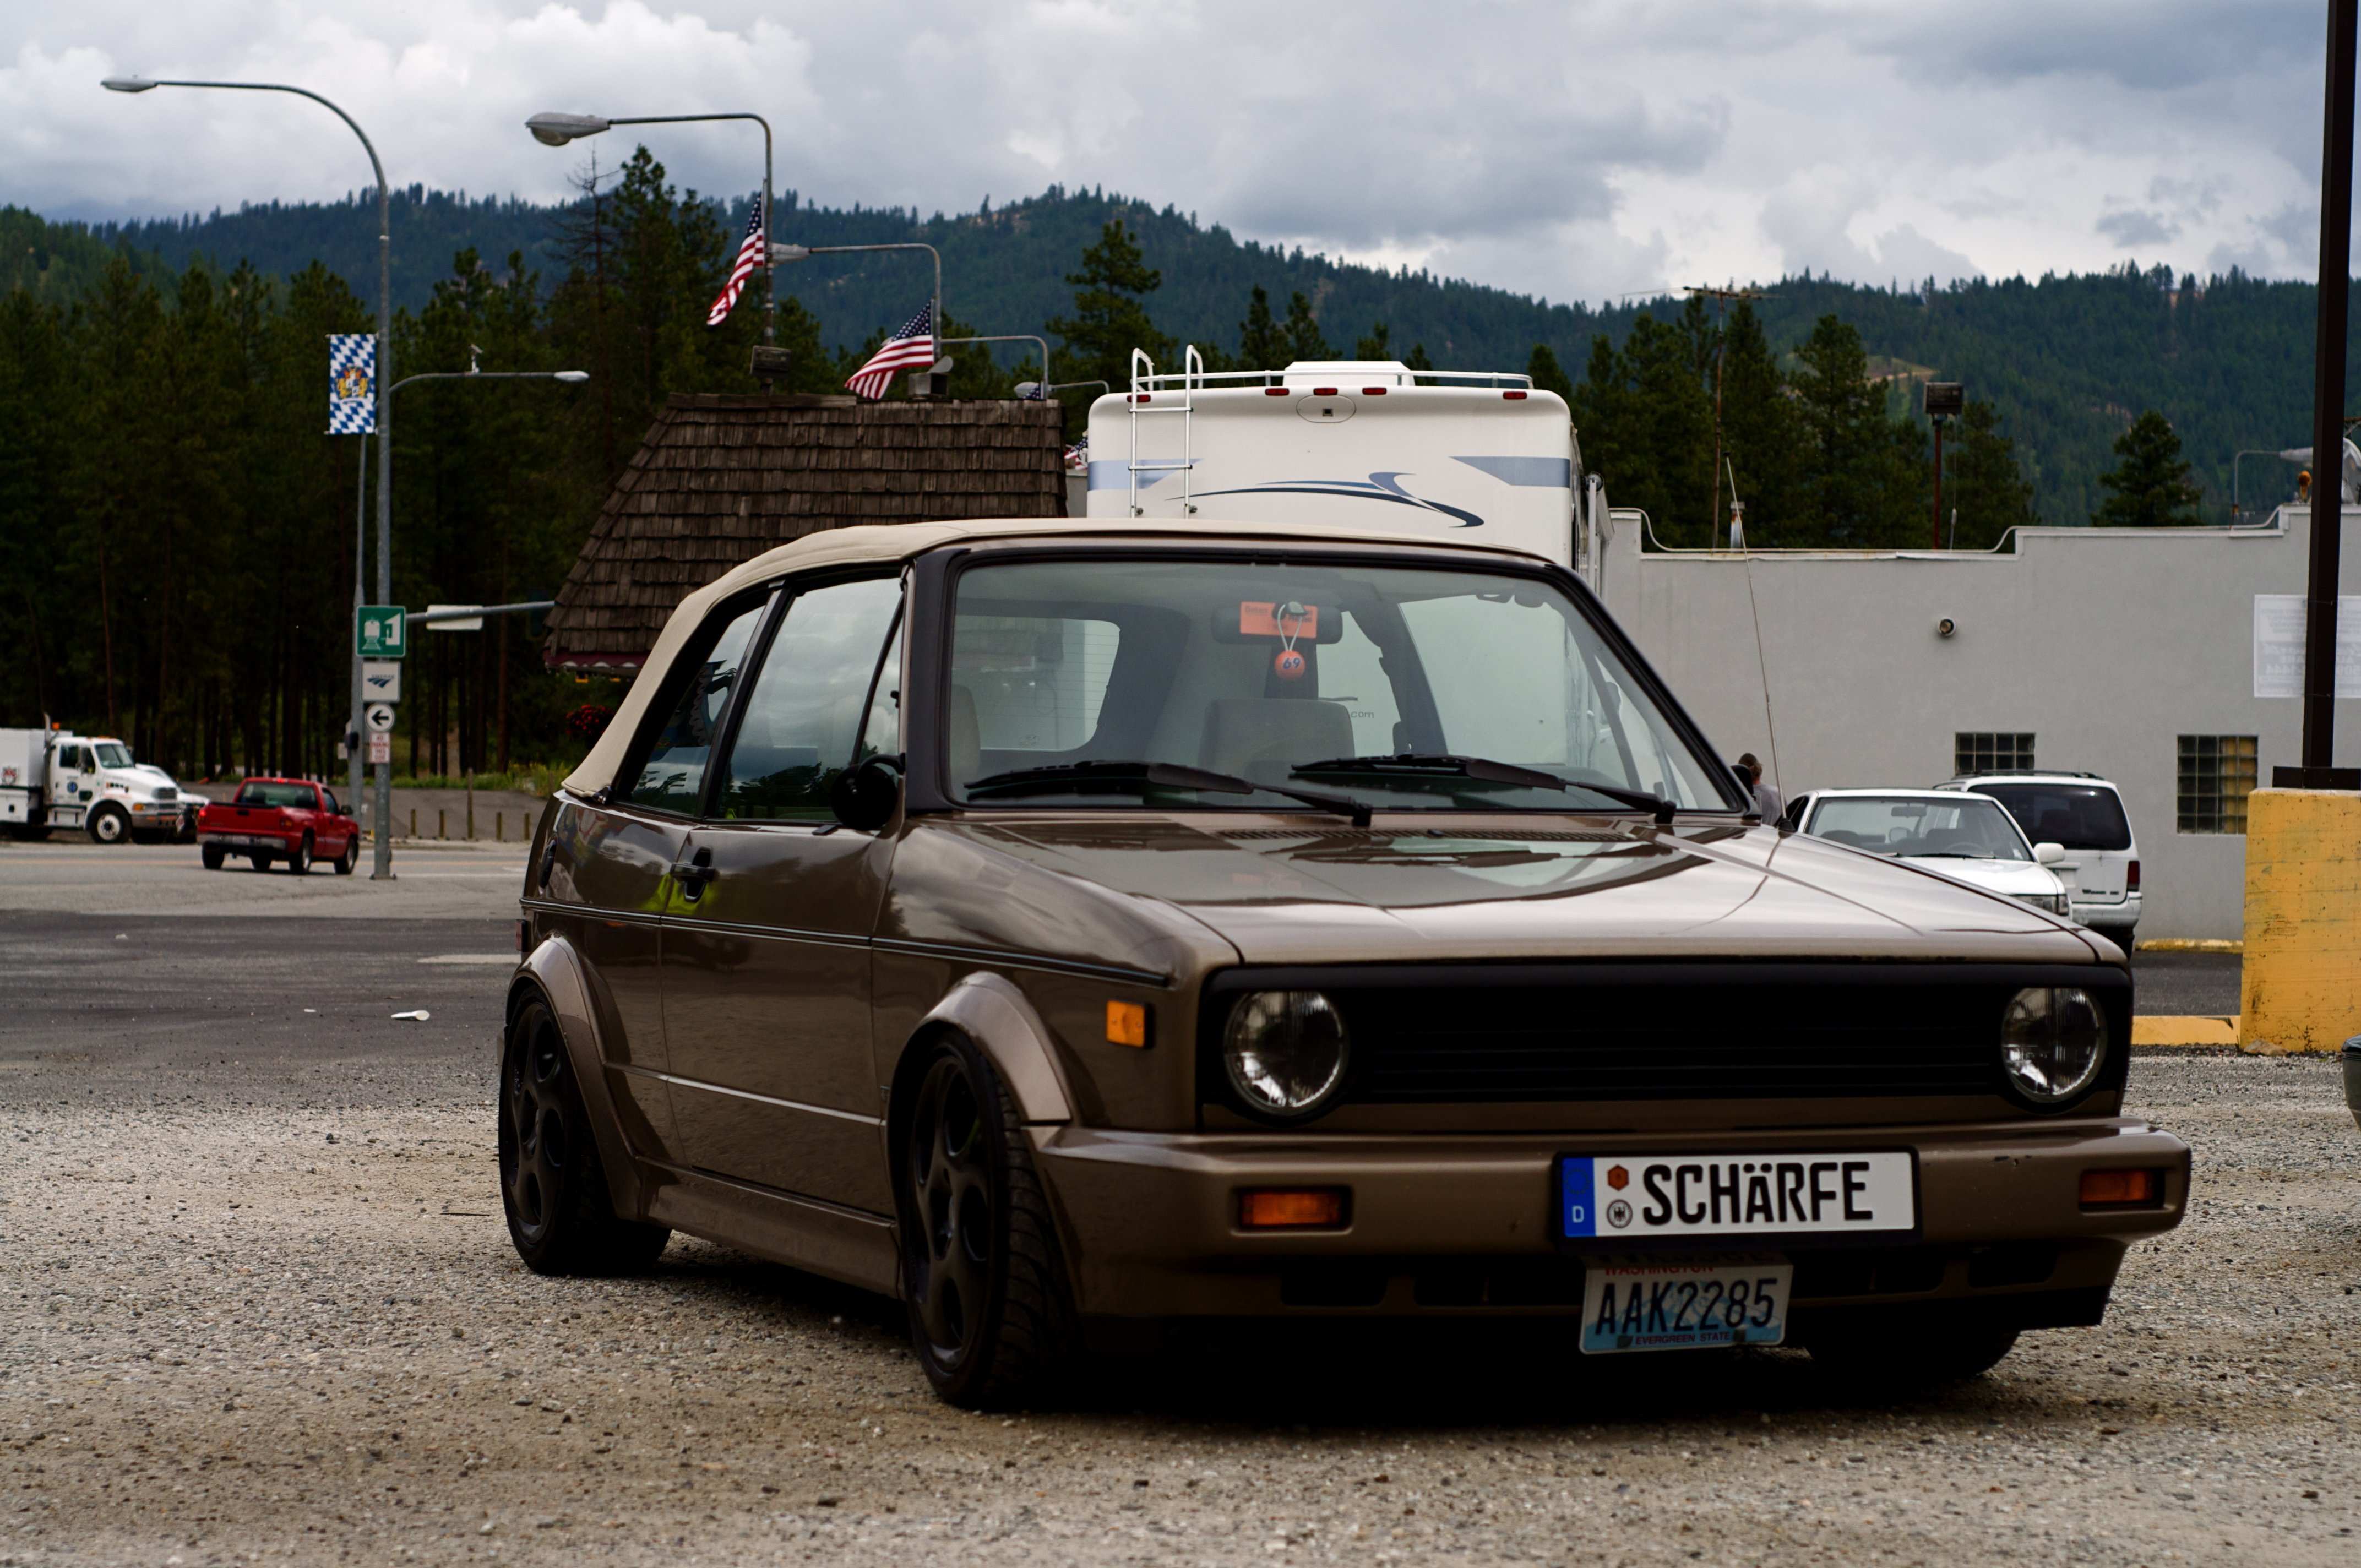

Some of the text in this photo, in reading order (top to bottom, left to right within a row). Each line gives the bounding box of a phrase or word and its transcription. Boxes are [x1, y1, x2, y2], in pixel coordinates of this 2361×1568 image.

[1282, 656, 1302, 669] 69
[1642, 1161, 1873, 1226] SCHÄRFE
[1573, 1206, 1584, 1223] D
[1595, 1278, 1778, 1335] AAK2285
[1635, 1331, 1731, 1346] EVERGREEN STATE
